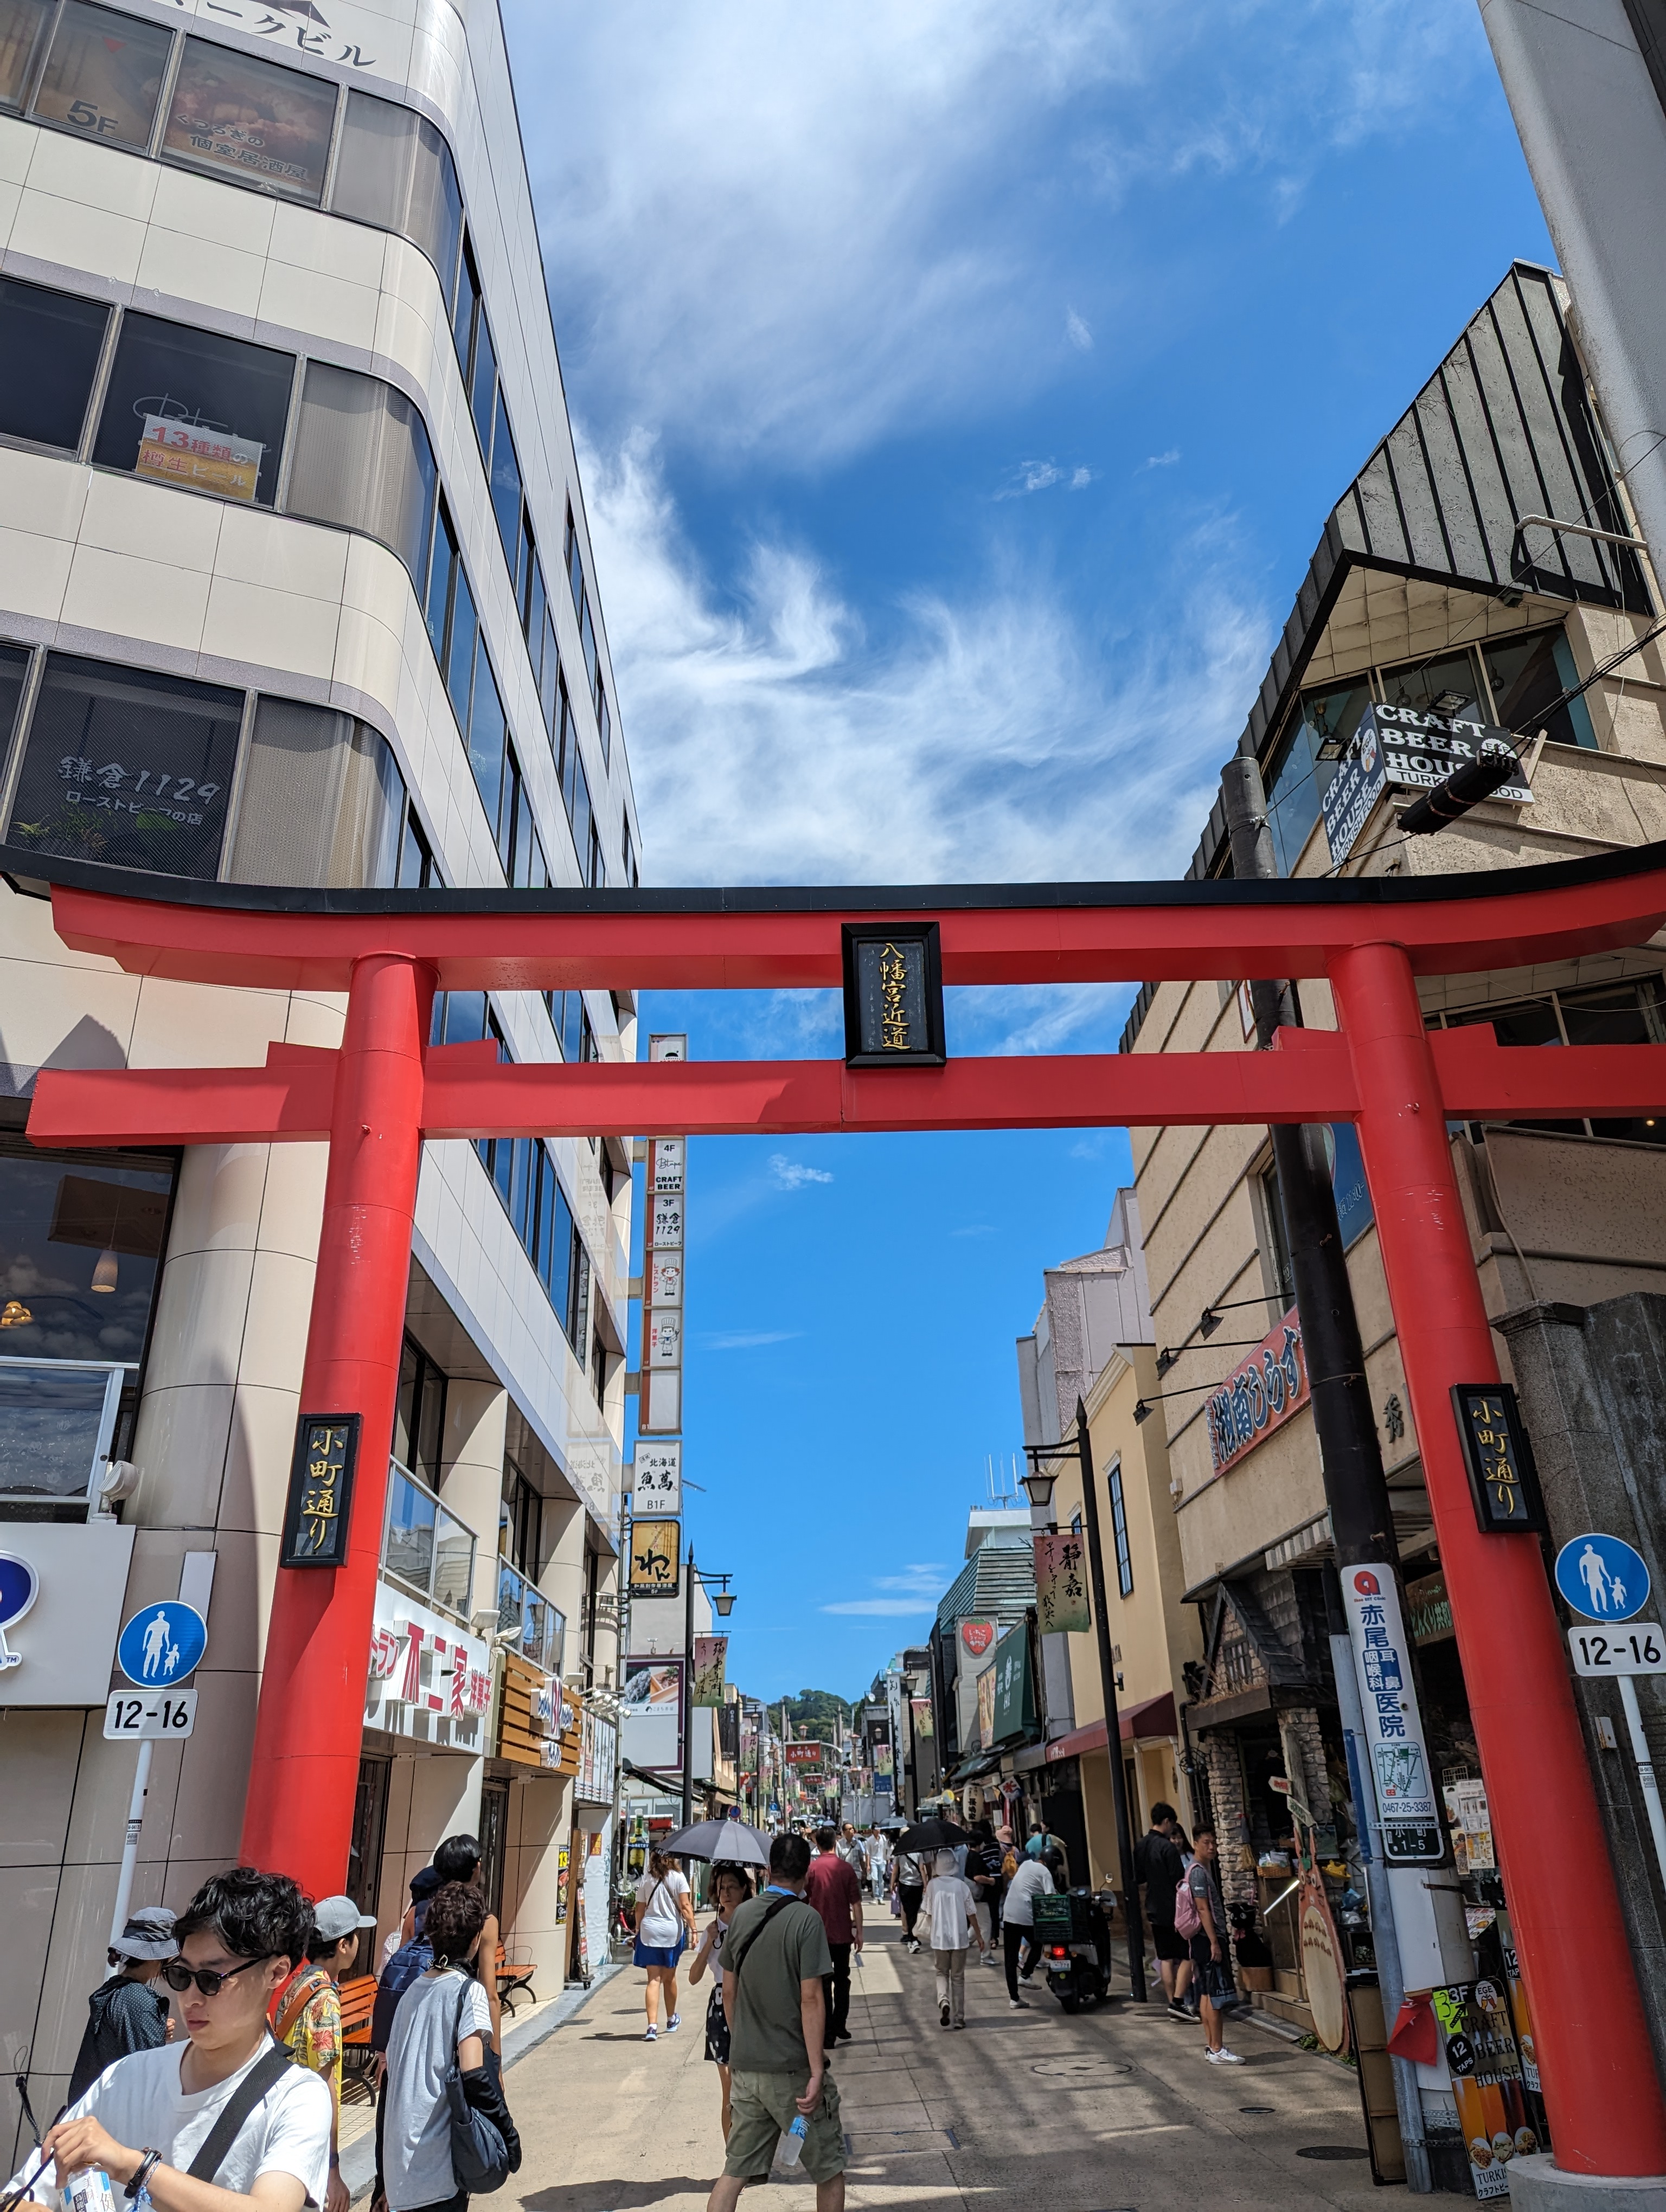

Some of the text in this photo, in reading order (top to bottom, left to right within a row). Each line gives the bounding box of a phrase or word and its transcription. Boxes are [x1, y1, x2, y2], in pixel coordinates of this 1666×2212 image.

[173, 0, 377, 67] ークビル
[67, 99, 119, 133] 5F
[177, 114, 265, 147] くつろぎの
[189, 135, 307, 181] 個室居酒屋
[152, 426, 249, 465] 13種類の
[142, 449, 247, 487] 樽生ビール
[1376, 704, 1486, 738] CRAFT
[1362, 731, 1373, 755] EGE
[1380, 728, 1476, 758] BEER
[59, 756, 220, 805] 鎌倉1129
[1323, 726, 1362, 812] CRAFT
[1327, 768, 1361, 838] BEER
[1362, 779, 1382, 820] FOOD
[1331, 776, 1372, 860] HOUSE
[879, 942, 912, 1050] 八幡宮近道
[656, 1212, 681, 1225] 鎌倉
[656, 1225, 681, 1234] 1129
[649, 1457, 676, 1467] 北海道
[1472, 1396, 1519, 1516] 小町通り
[303, 1426, 344, 1552] 小町通り
[637, 1470, 674, 1491] 魚萬
[647, 1500, 665, 1509] B1F
[634, 1548, 671, 1582] わん
[1360, 1604, 1389, 1649] 赤尾
[1410, 1600, 1452, 1637] どんぐり共和
[1578, 1635, 1662, 1666] 12-16
[401, 1622, 469, 1722] 不二家
[470, 1666, 492, 1718] 洋菓子
[114, 1700, 188, 1729] 12-16
[1376, 1693, 1406, 1738] 医院
[790, 1750, 816, 1758] 小町通り
[1382, 1802, 1432, 1813] 0467-25-3387
[1401, 1840, 1426, 1851] 1-5
[1507, 1969, 1520, 1978] TAP
[1448, 1985, 1469, 2004] 3F
[1478, 1986, 1494, 1995] EGE
[1462, 2010, 1508, 2034] CRAFT
[1452, 2041, 1468, 2057] 12
[1476, 2036, 1515, 2060] BEER
[1456, 2056, 1474, 2073] TAPS
[1475, 2065, 1521, 2088] HOUSE
